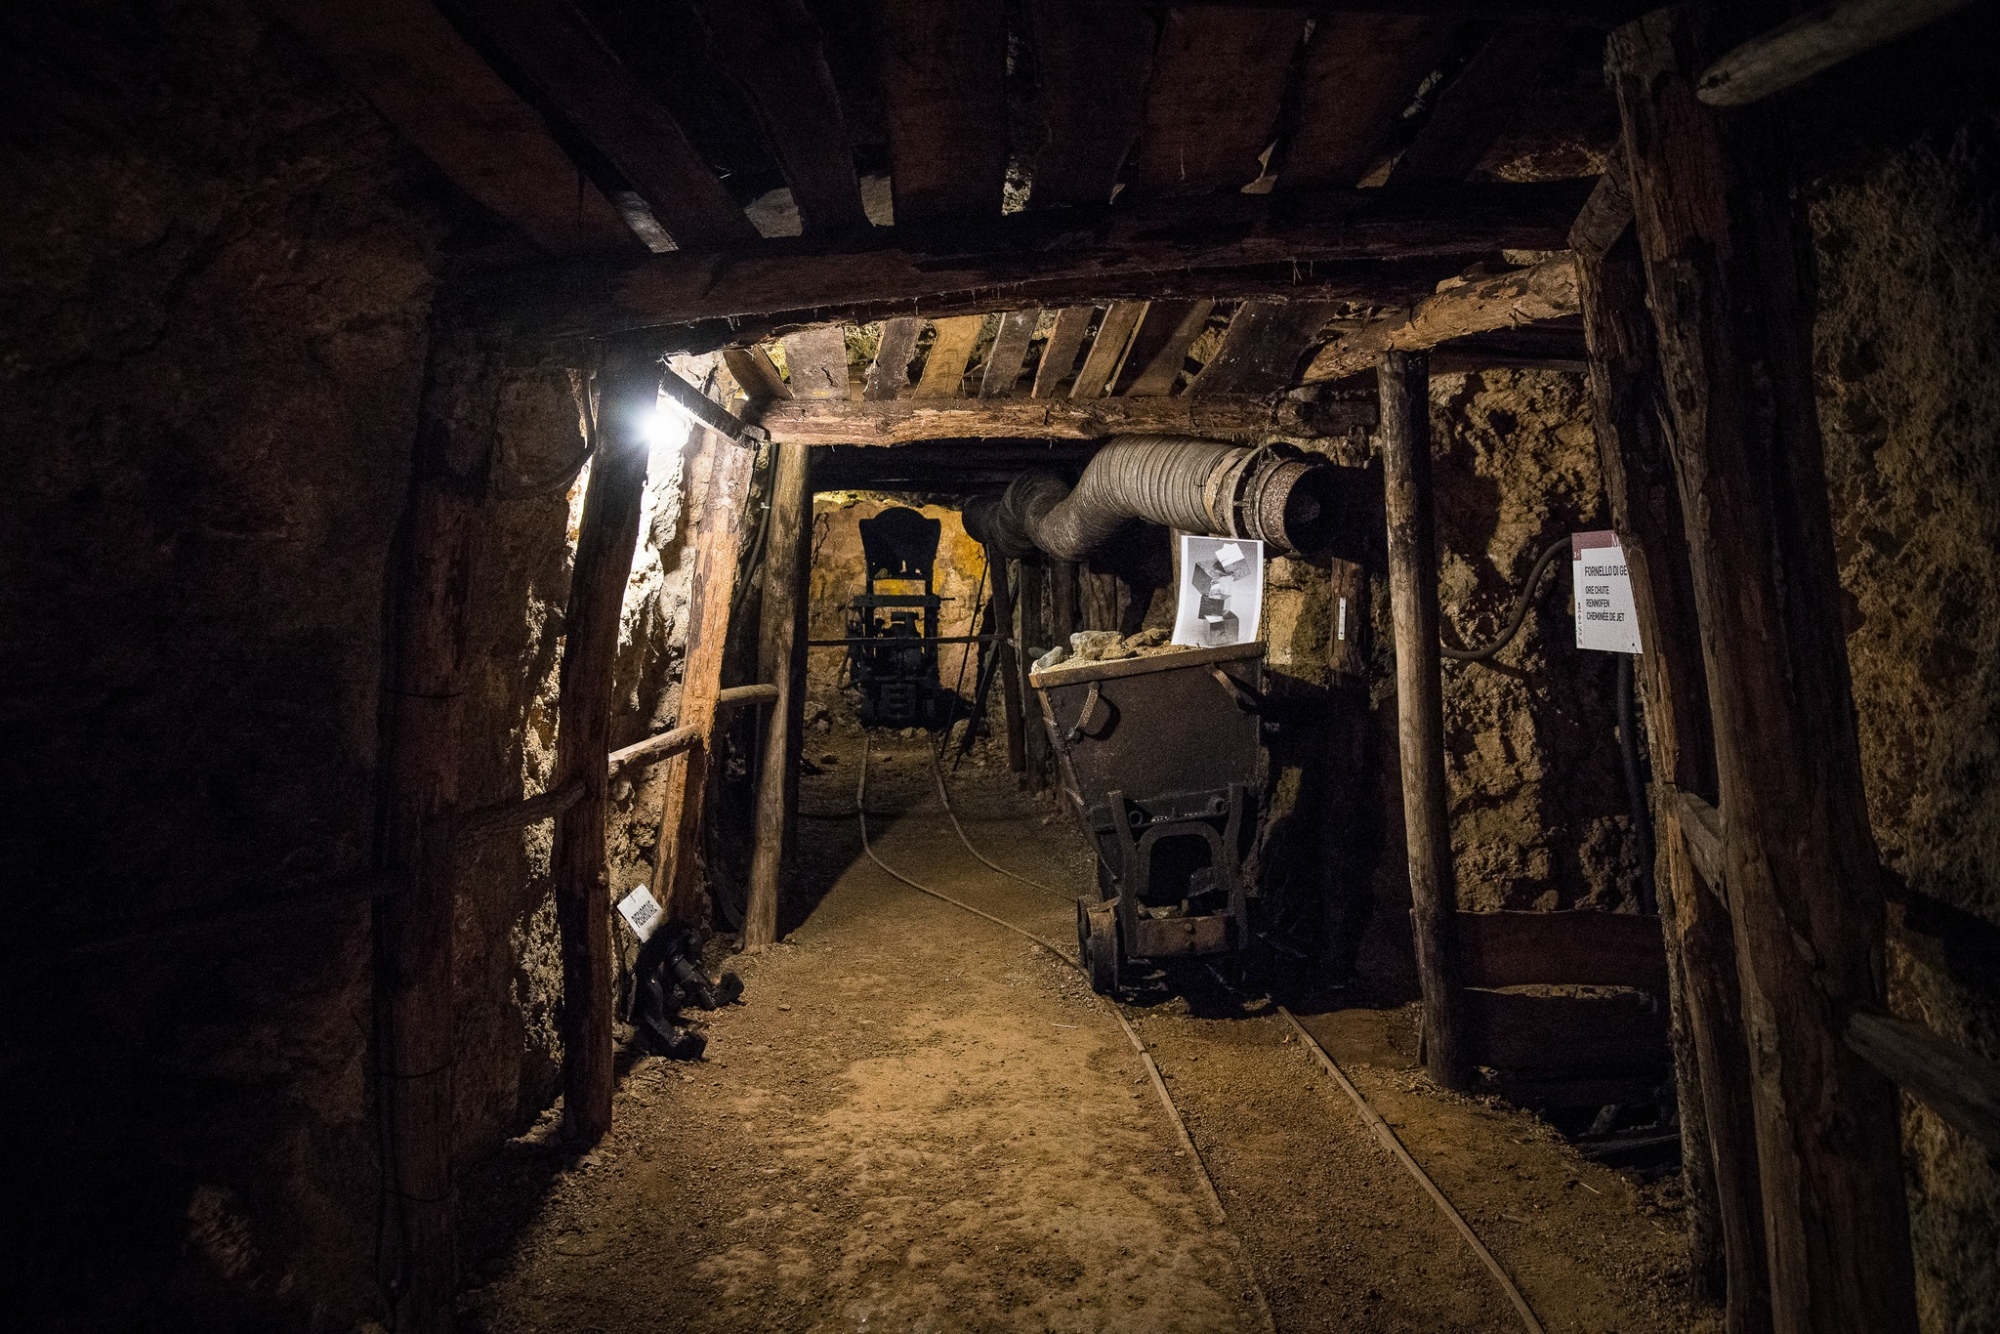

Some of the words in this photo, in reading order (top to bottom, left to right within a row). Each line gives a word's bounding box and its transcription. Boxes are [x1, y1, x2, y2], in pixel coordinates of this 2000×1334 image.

[1585, 565, 1612, 577] FORNELLO
[1613, 565, 1619, 576] DI
[1585, 585, 1594, 594] ORE
[1595, 585, 1609, 594] CHUTE
[1586, 598, 1610, 608] RENNOFEN
[1586, 609, 1609, 621] CHEMINÉE
[1609, 612, 1616, 621] DE
[1616, 612, 1625, 622] JET
